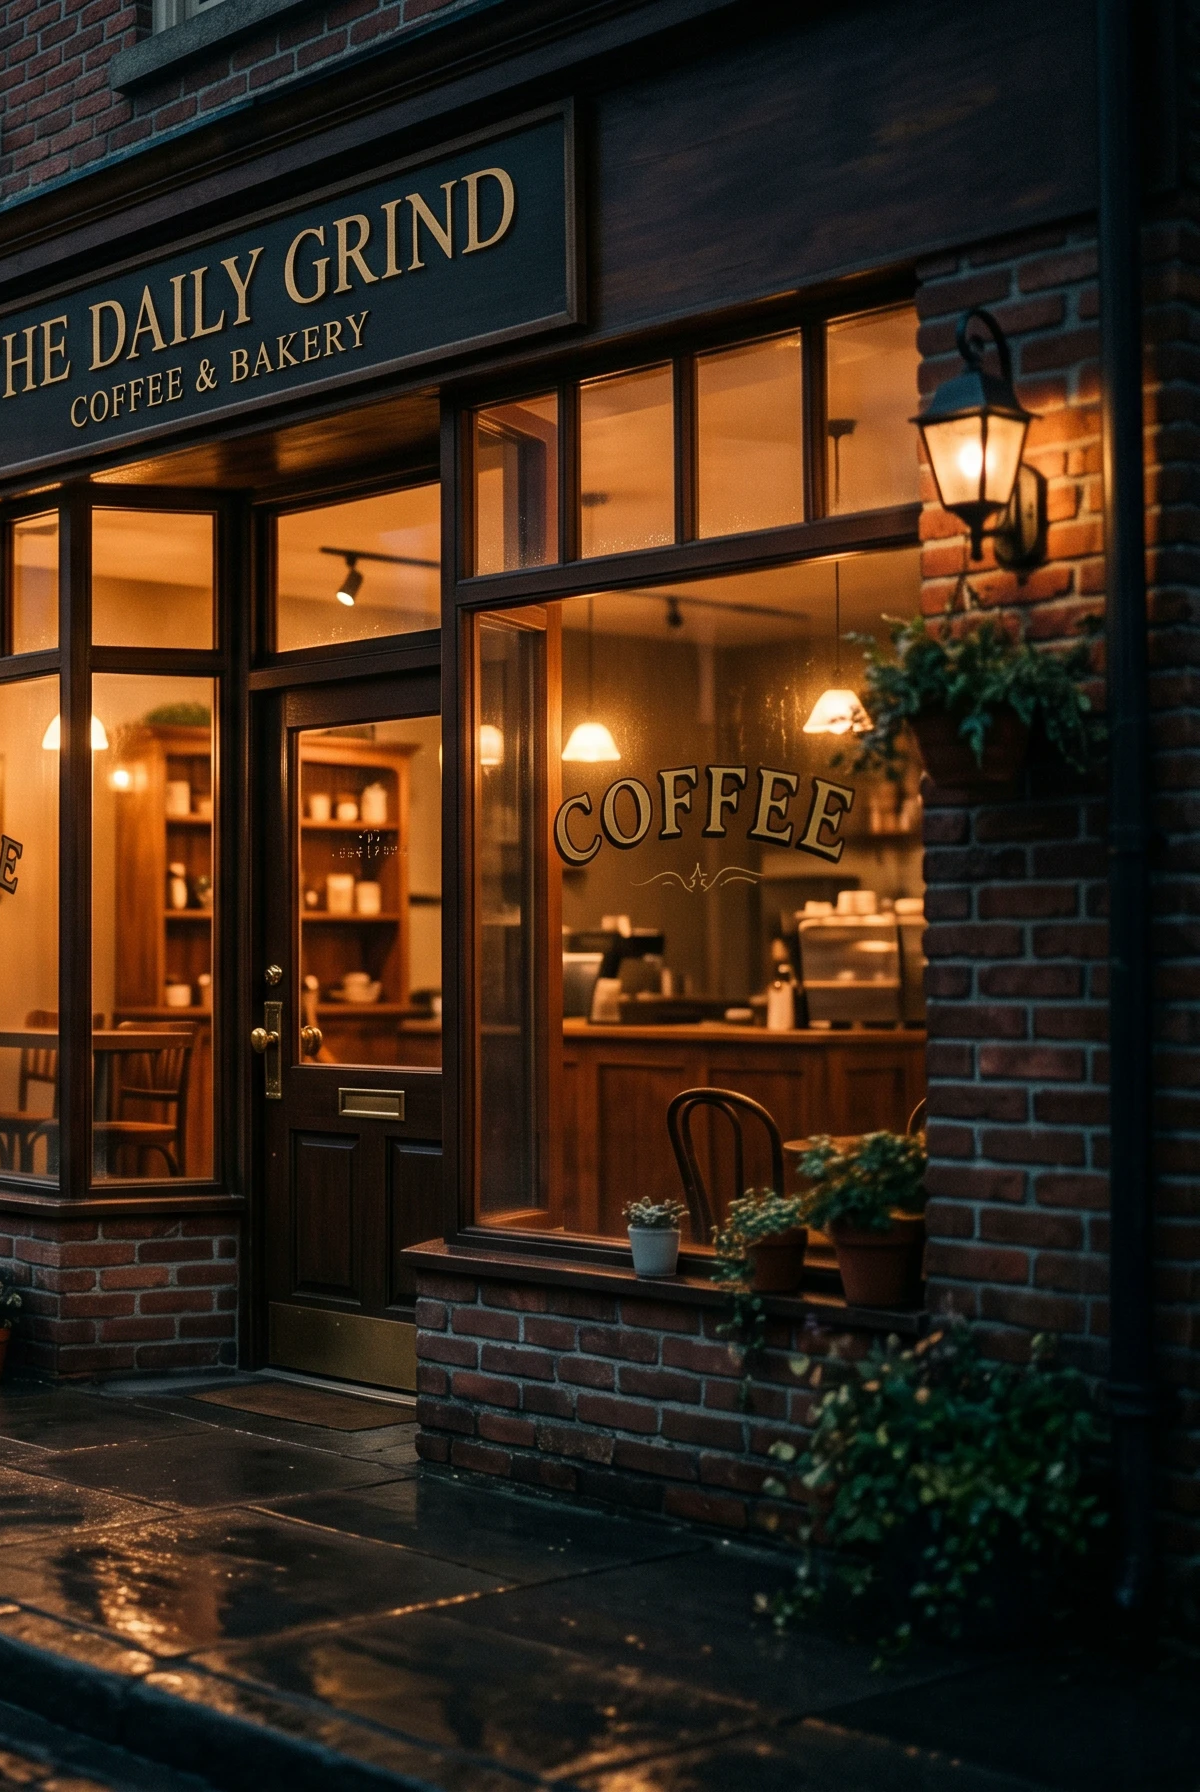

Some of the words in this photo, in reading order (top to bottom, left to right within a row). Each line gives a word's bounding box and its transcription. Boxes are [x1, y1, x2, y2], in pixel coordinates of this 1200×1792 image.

[88, 246, 265, 372] DAILY
[284, 166, 516, 305] GRIND
[70, 366, 185, 429] COFFEE
[195, 358, 218, 393] &
[230, 310, 371, 384] BAKERY
[553, 765, 855, 868] COFFEE
